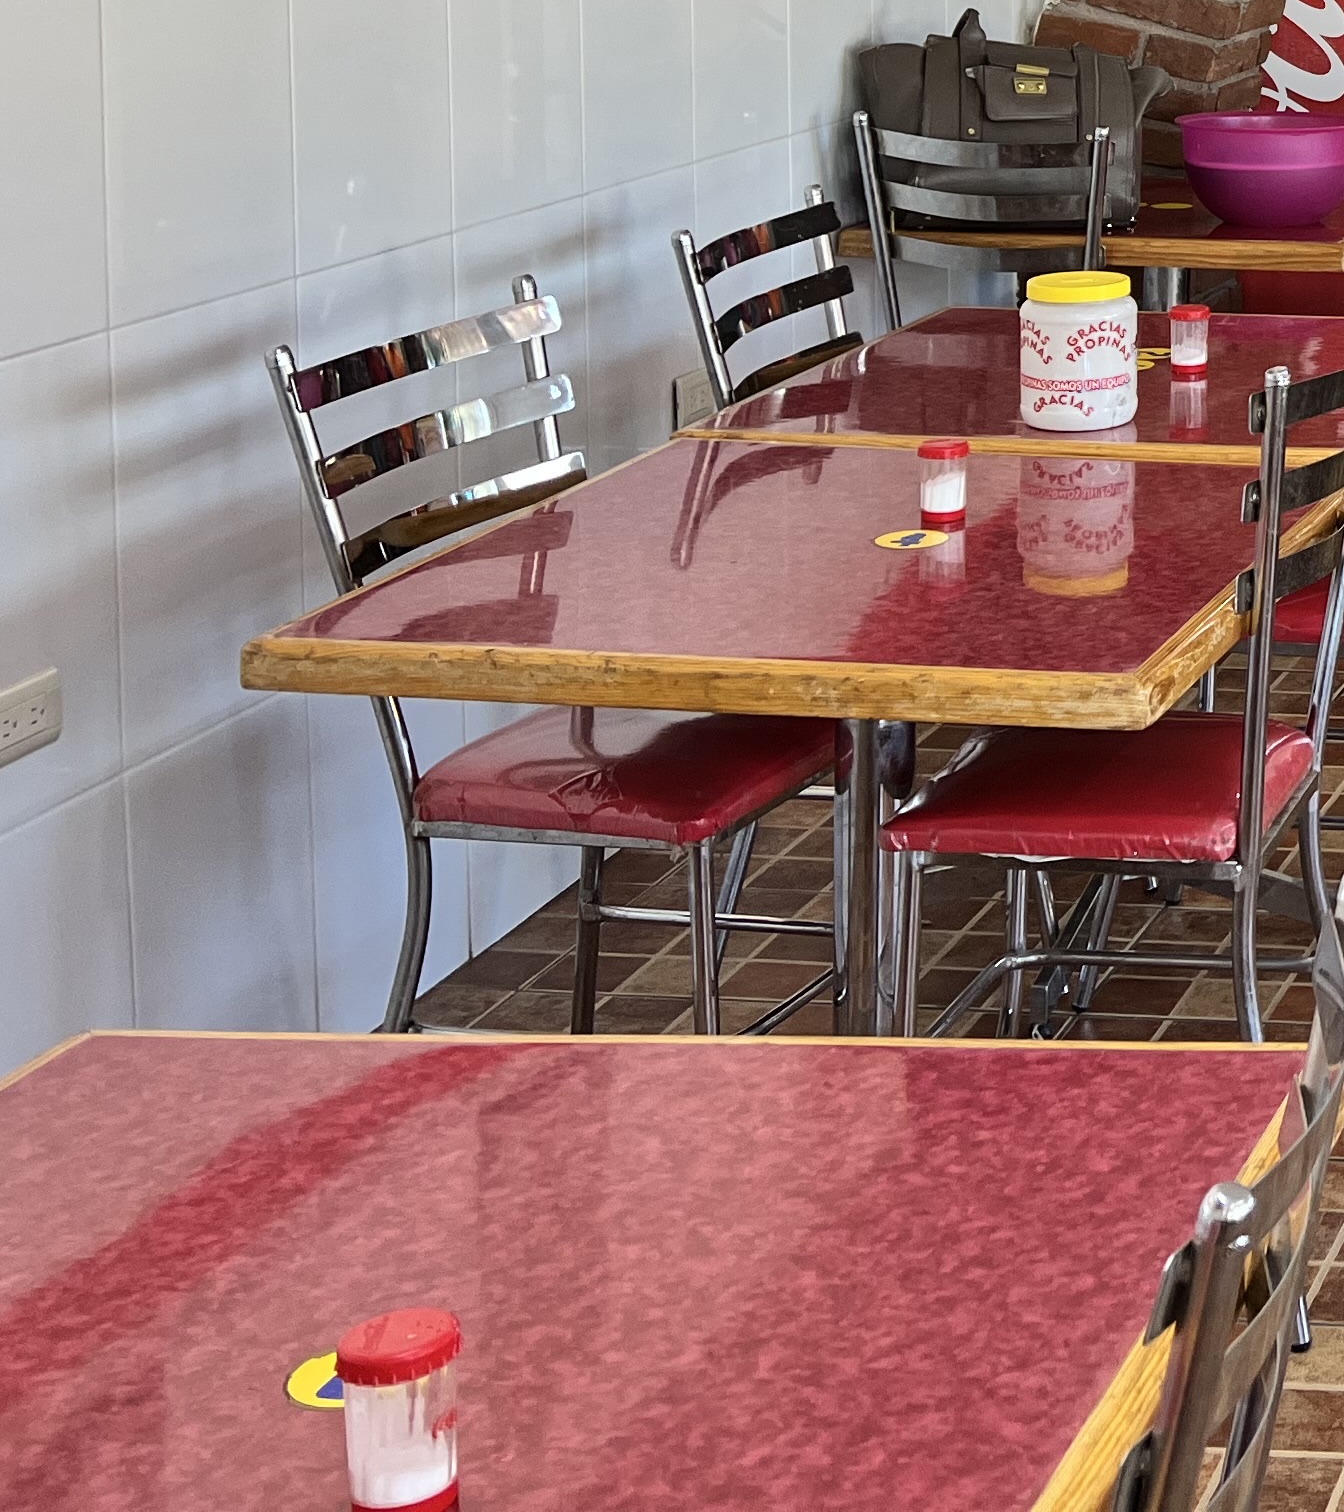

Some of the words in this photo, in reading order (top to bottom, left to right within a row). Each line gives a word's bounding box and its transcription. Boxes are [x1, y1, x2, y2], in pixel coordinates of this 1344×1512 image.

[1066, 320, 1127, 346] GRACIAS
[1065, 335, 1131, 363] PROPINAS
[1048, 380, 1082, 392] SOMOS
[1084, 379, 1100, 391] UN
[1033, 394, 1095, 417] GRACIAS
